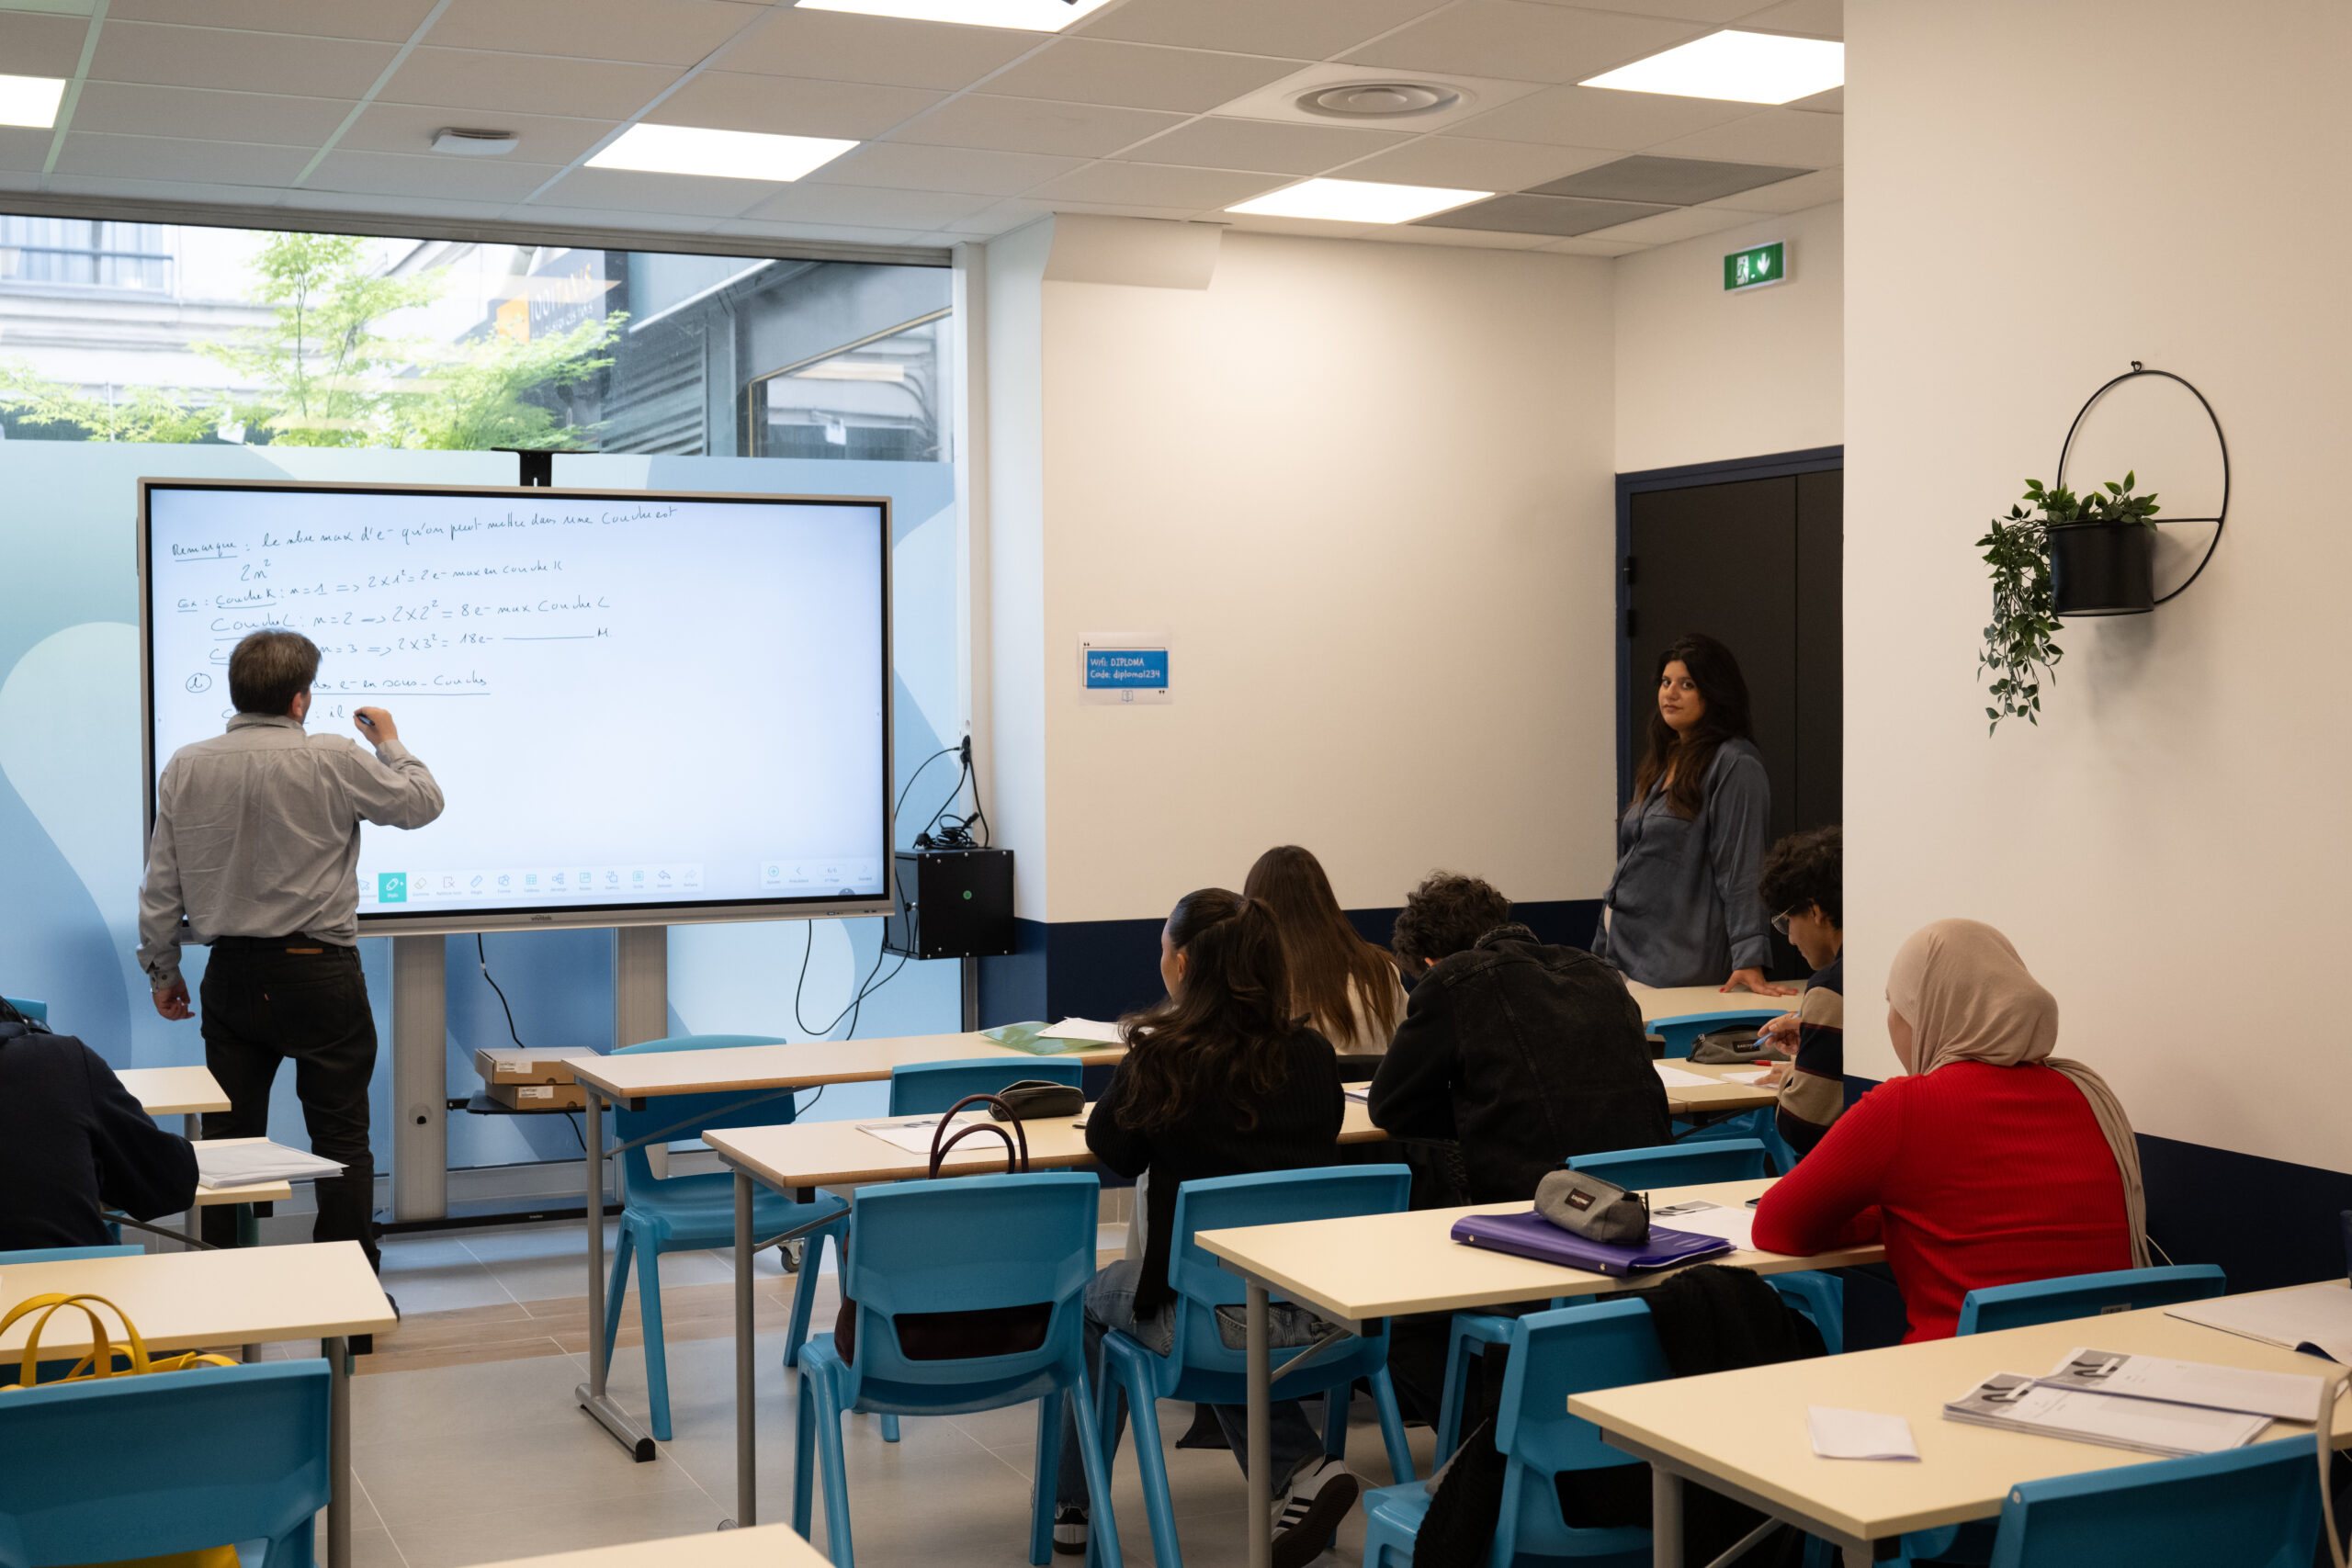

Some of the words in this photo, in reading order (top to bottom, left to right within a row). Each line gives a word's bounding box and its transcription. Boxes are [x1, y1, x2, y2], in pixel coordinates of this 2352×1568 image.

[172, 541, 237, 558] Remarque
[321, 534, 354, 542] max
[401, 523, 445, 545] qu'on
[450, 517, 482, 540] peut
[487, 512, 526, 529] mettre
[531, 513, 557, 525] dans
[562, 516, 594, 525] une
[655, 506, 677, 519] est
[497, 604, 531, 615] max
[1110, 657, 1145, 667] DIPLOMA
[1090, 670, 1111, 679] Code:
[1113, 669, 1160, 681] diploma1234
